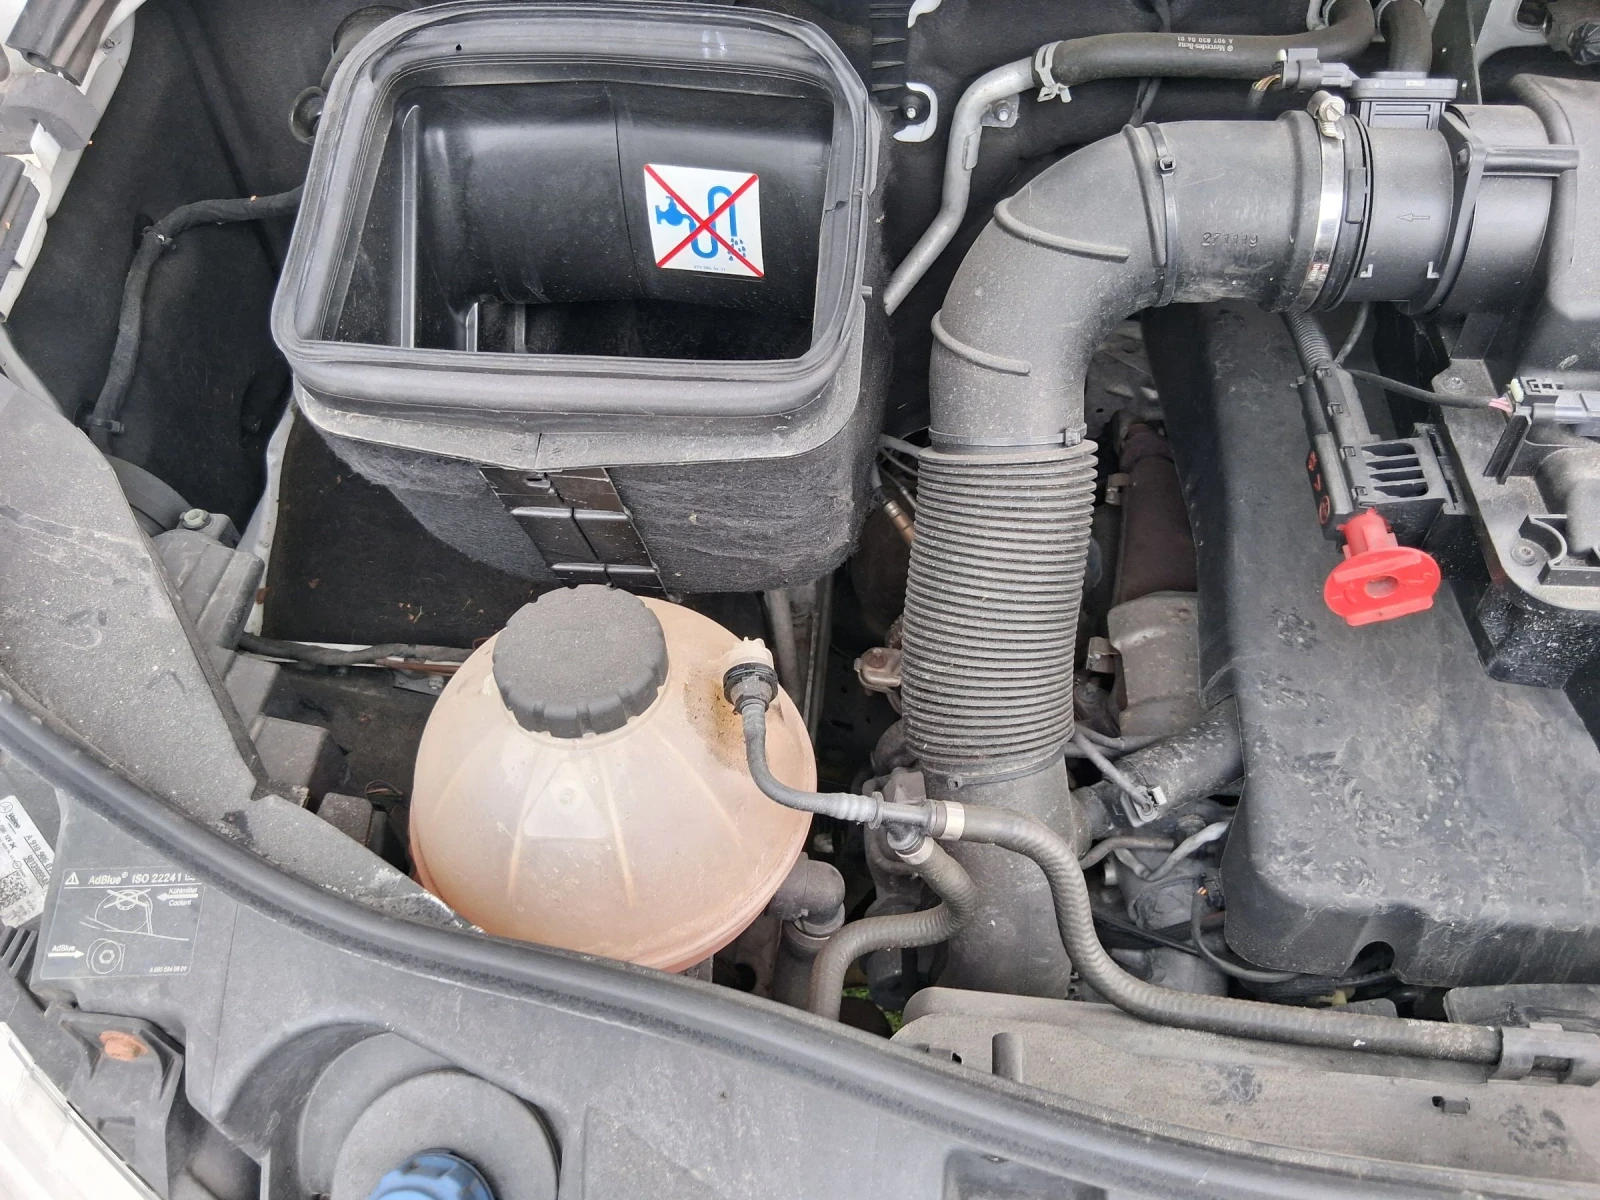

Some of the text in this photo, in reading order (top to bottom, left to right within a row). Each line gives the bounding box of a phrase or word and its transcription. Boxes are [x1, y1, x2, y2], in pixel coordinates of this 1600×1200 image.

[1178, 42, 1225, 52] Mercedes-Benz
[1202, 232, 1258, 247] 271119
[131, 873, 149, 884] ISO
[151, 872, 182, 884] 22241
[168, 899, 192, 907] Coolant
[51, 944, 76, 952] AdBlue
